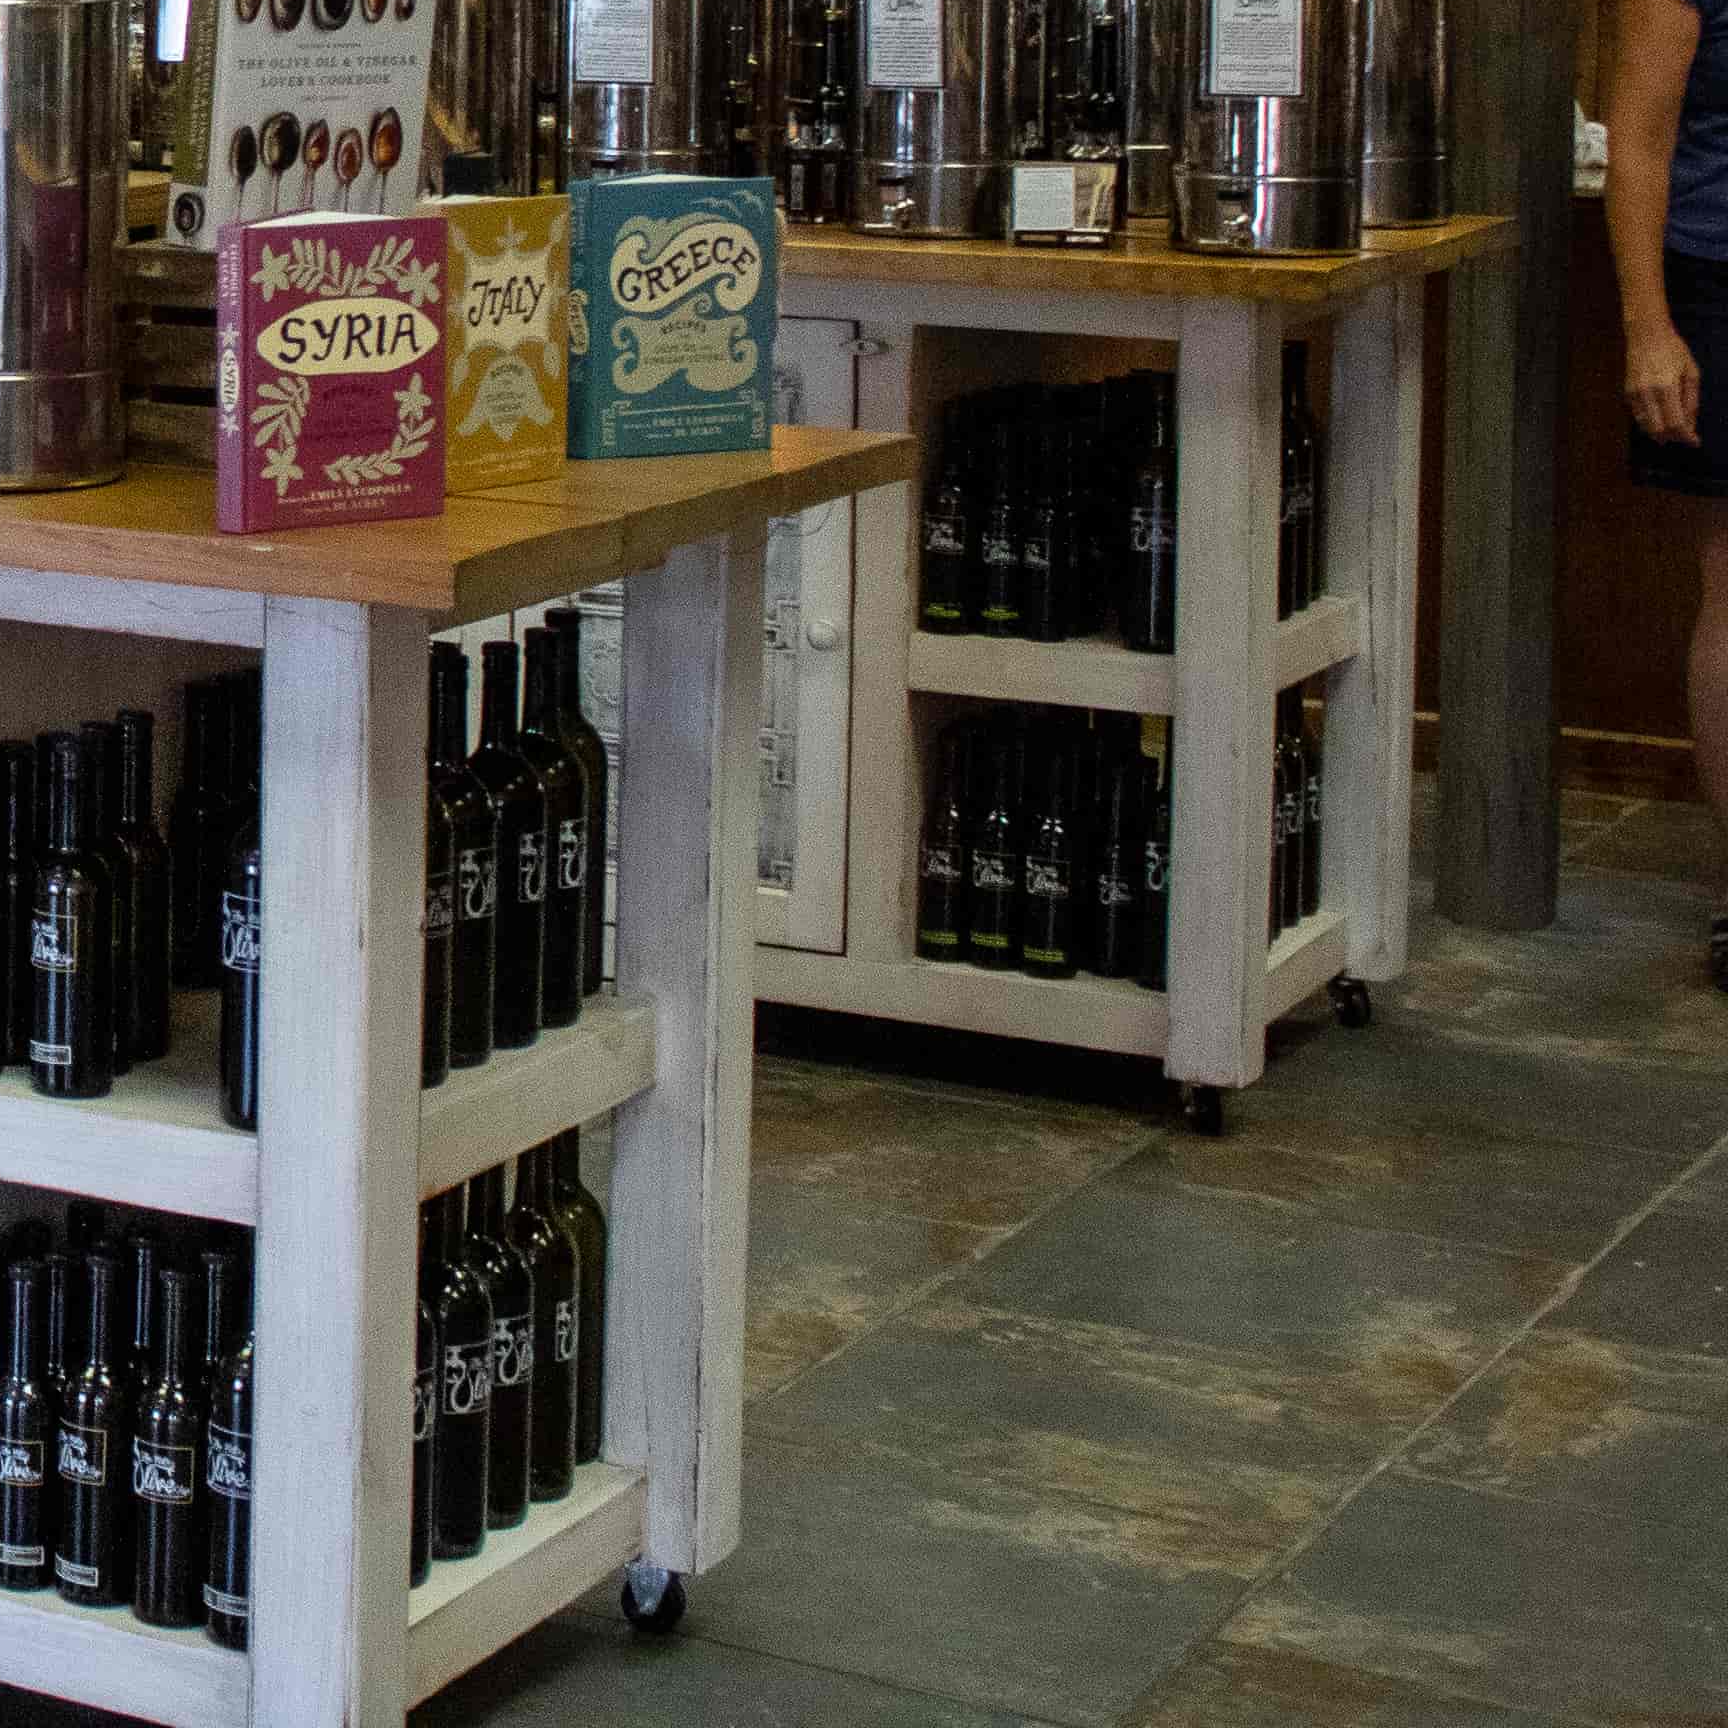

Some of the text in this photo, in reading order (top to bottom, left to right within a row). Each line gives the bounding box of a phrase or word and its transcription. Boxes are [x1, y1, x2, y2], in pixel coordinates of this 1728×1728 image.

[238, 58, 265, 70] THE
[269, 56, 311, 69] OLIVE
[315, 55, 338, 68] OIL
[357, 54, 418, 67] VINEGAR
[319, 74, 391, 86] COOKBOOK
[618, 236, 756, 303] GREECE
[468, 275, 545, 327] ITALY
[278, 313, 420, 363] SYRIA
